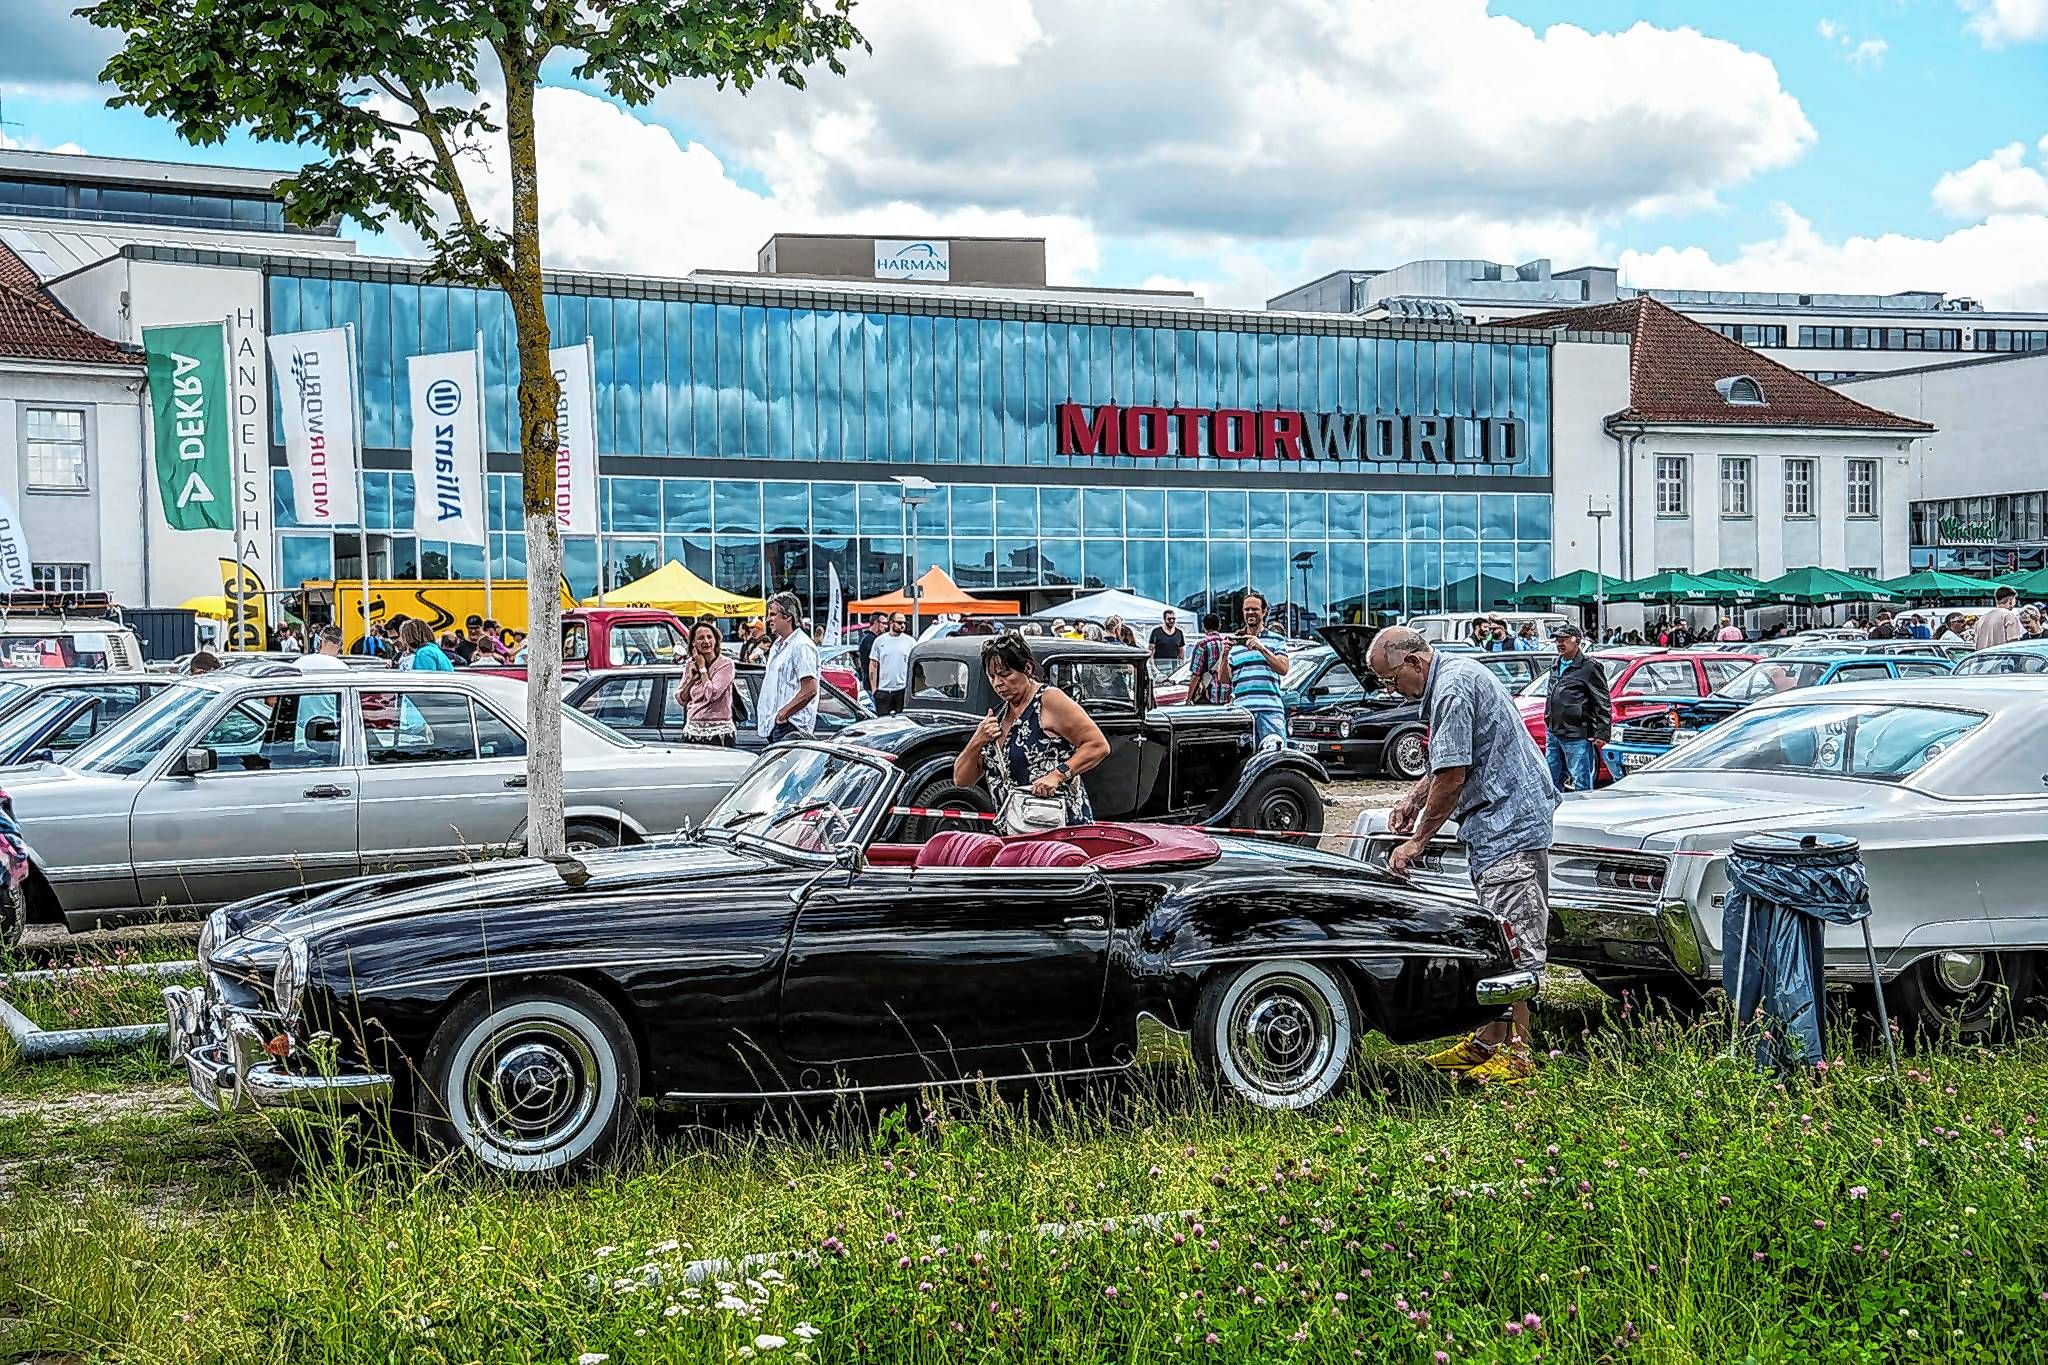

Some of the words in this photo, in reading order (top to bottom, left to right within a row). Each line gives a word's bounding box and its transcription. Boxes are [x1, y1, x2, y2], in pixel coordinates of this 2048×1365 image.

[877, 258, 947, 271] HARMAN
[237, 307, 260, 560] HANDELSHA
[1056, 403, 1526, 464] MOTORWORLD
